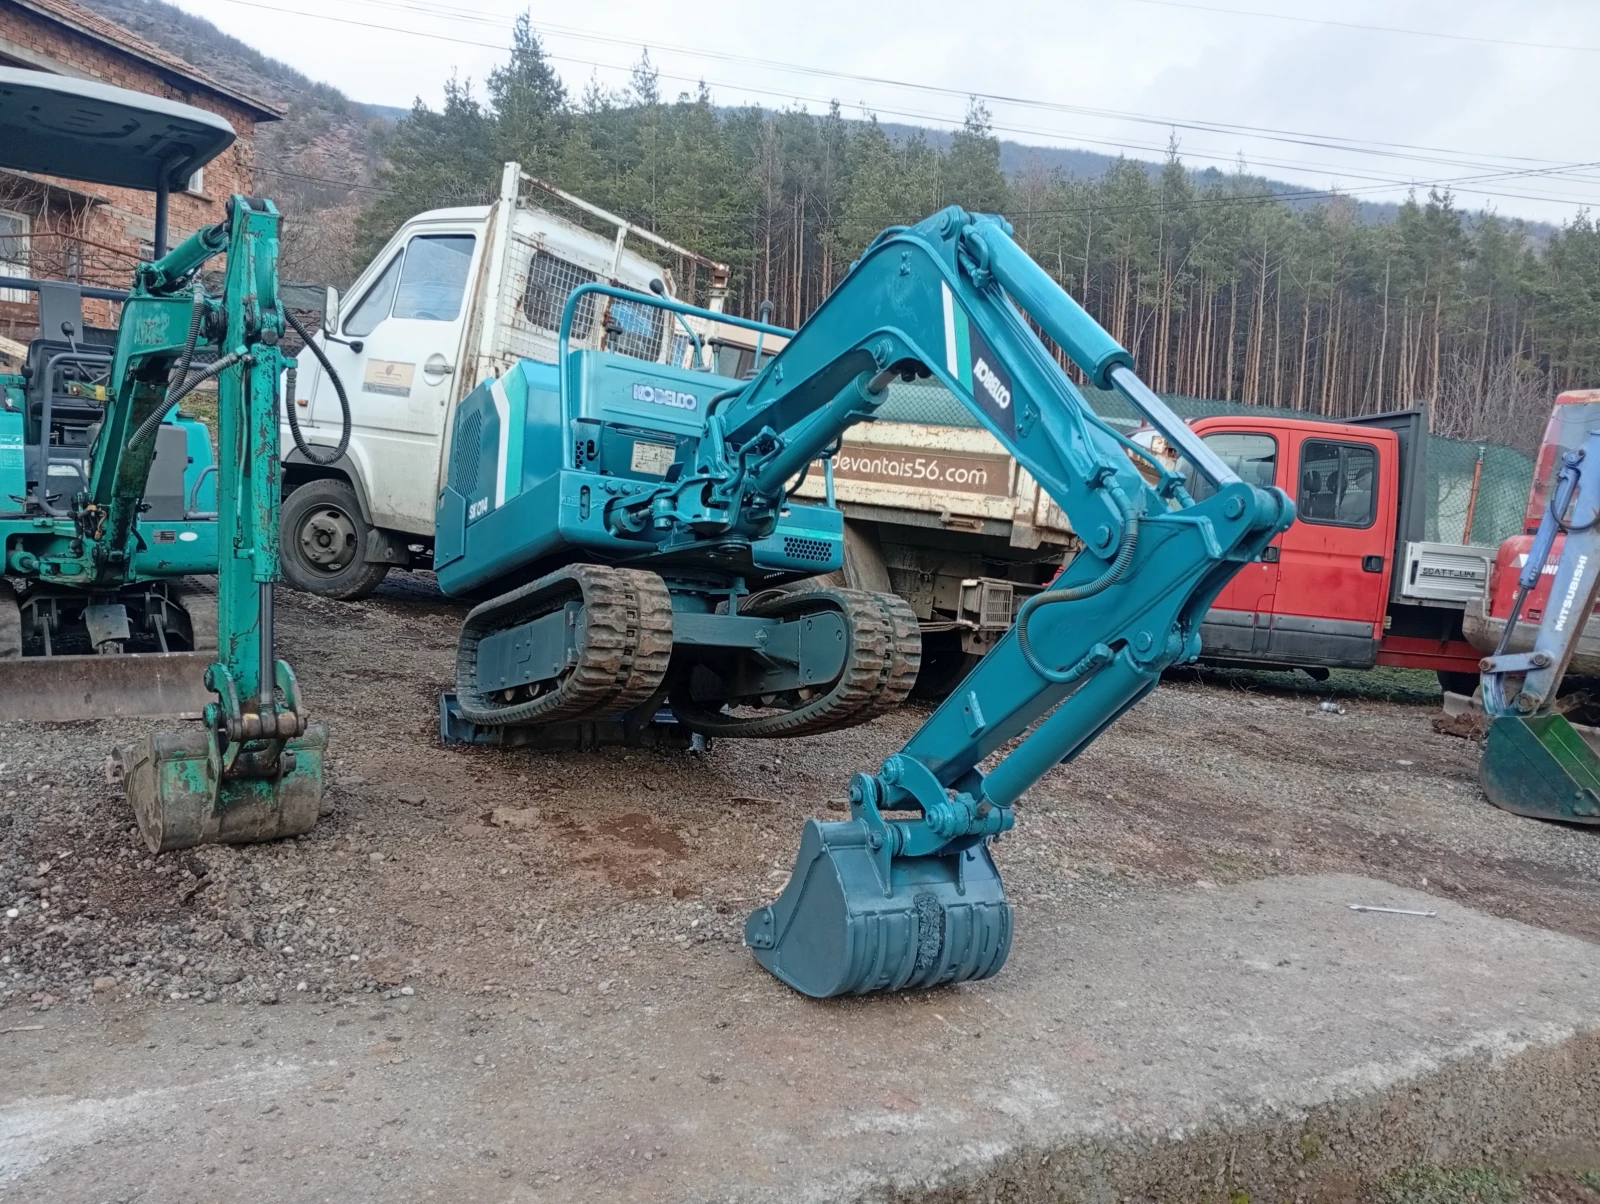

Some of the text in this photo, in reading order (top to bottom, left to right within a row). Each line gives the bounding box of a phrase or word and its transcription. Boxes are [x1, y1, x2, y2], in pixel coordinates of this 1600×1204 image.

[633, 384, 697, 410] KOBELCO
[973, 356, 1011, 409] KOBELCO
[1554, 555, 1588, 632] MITSUBISHI
